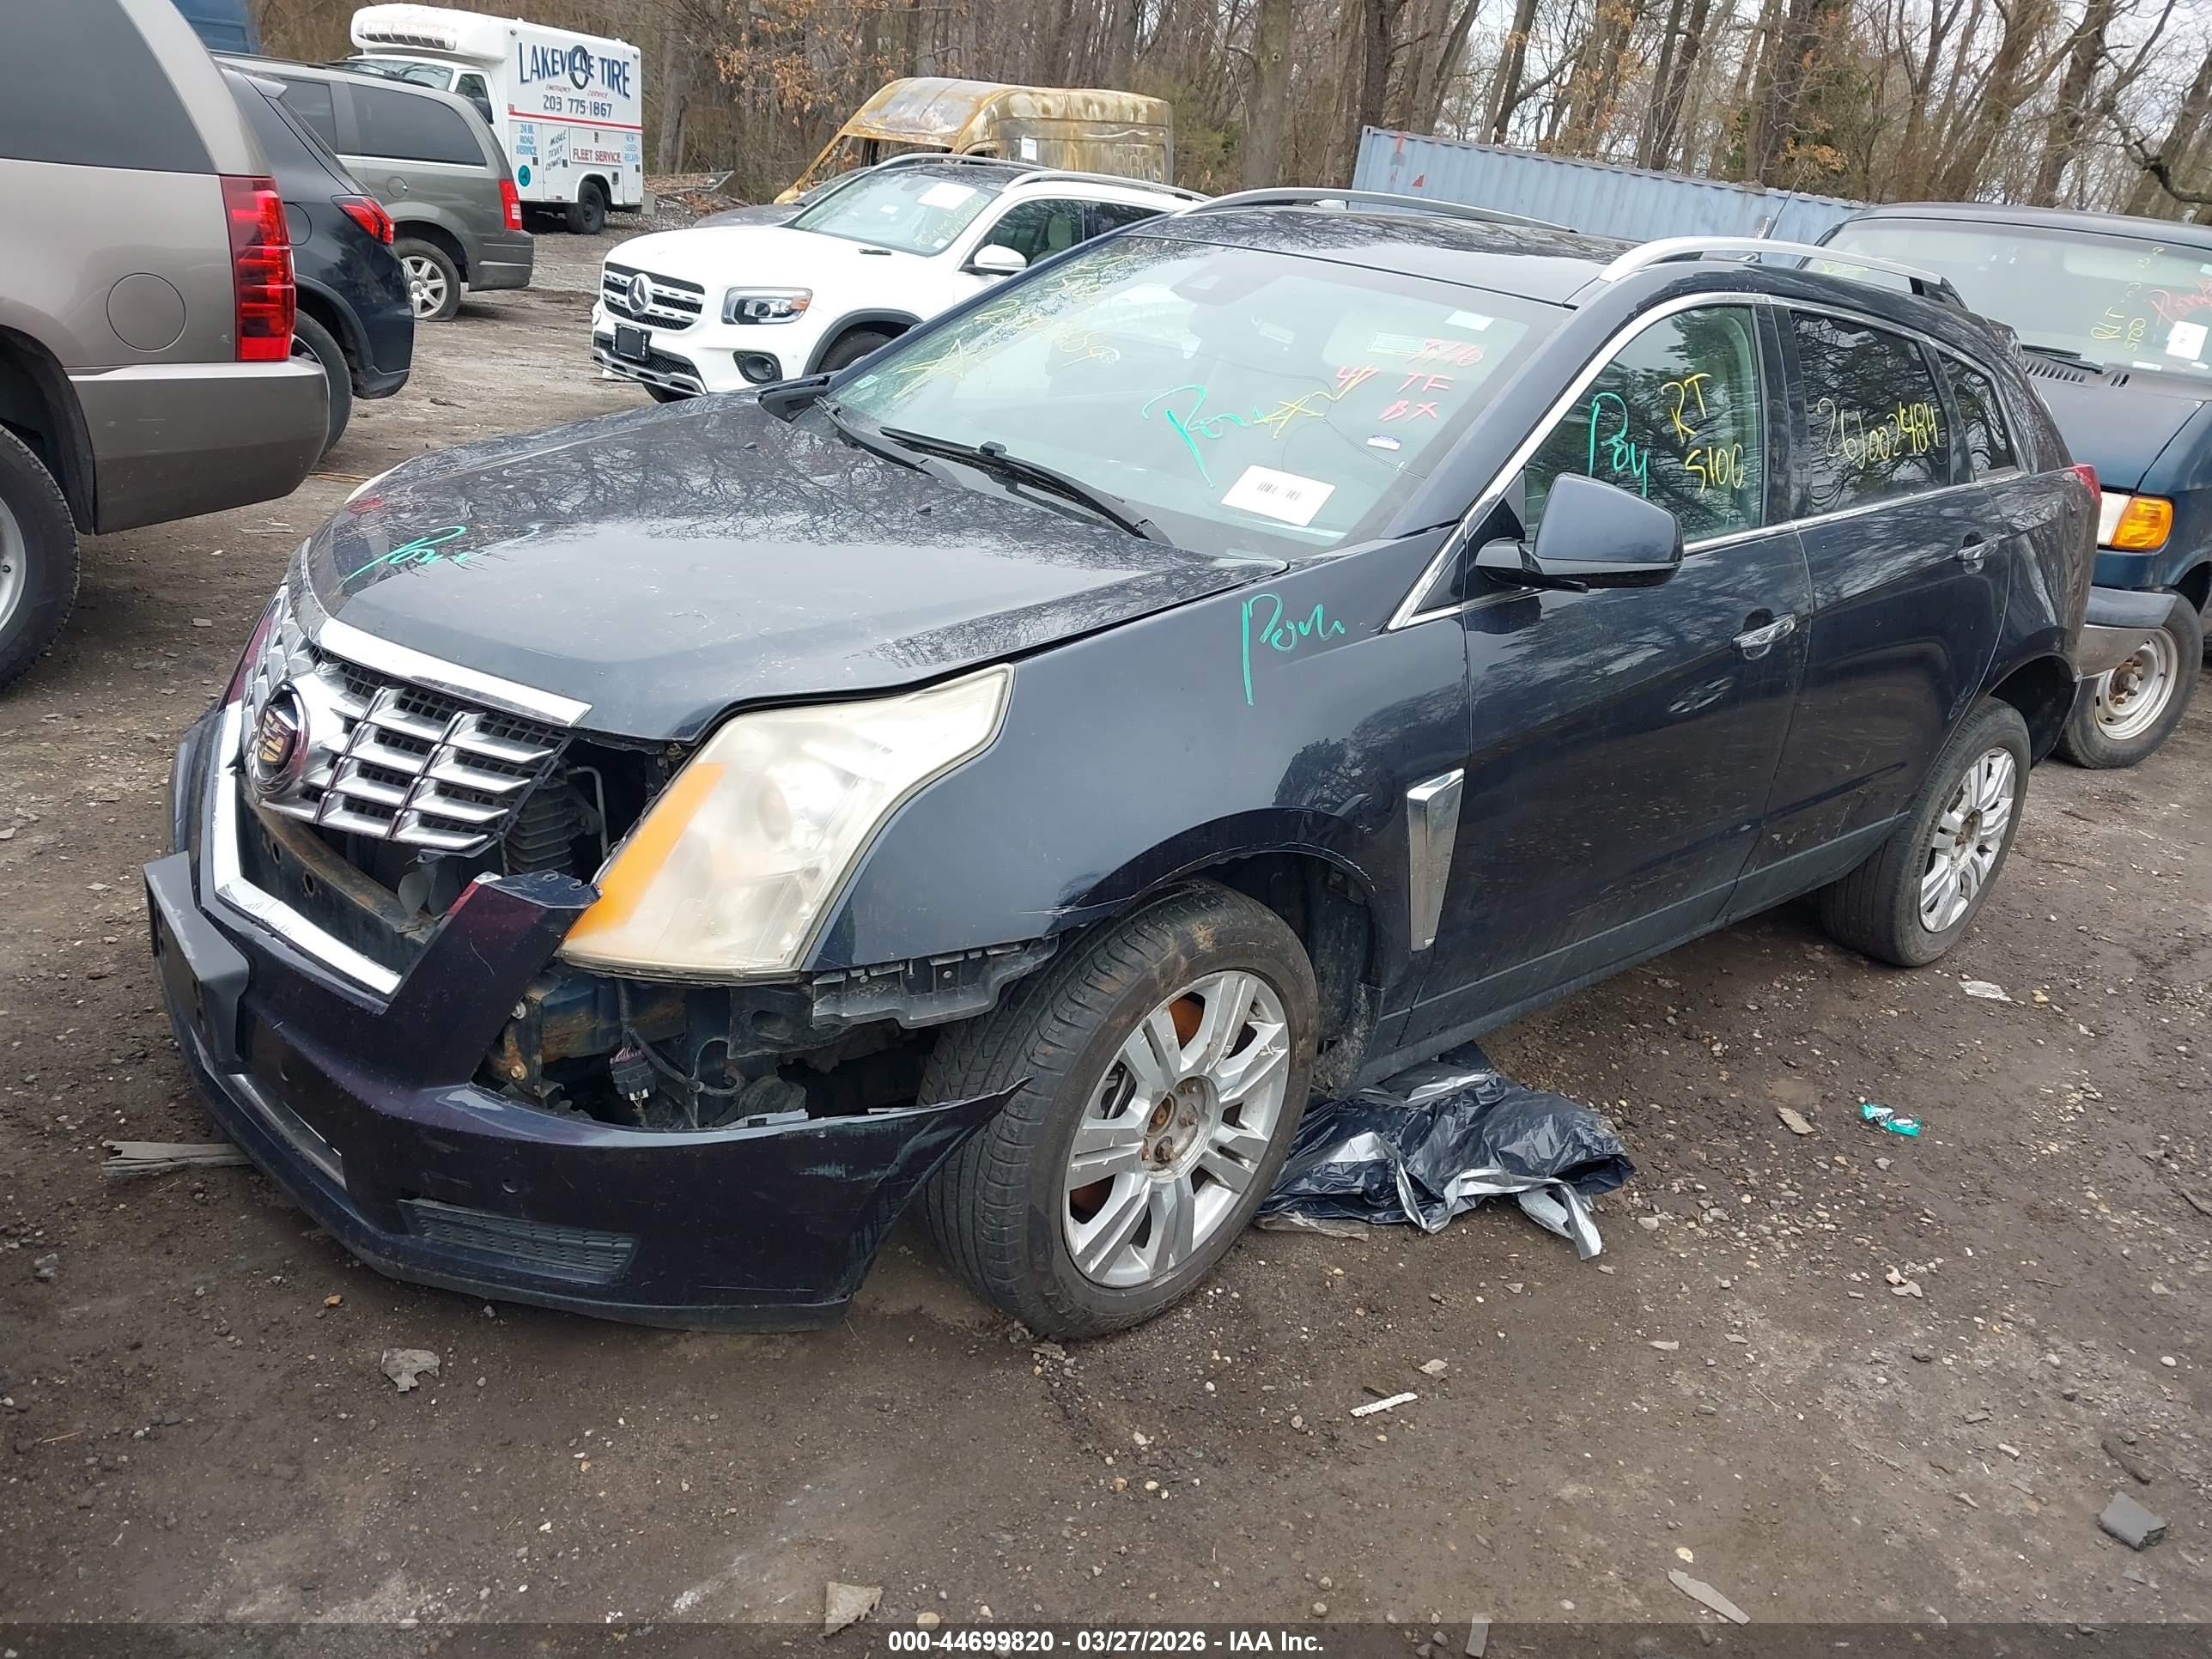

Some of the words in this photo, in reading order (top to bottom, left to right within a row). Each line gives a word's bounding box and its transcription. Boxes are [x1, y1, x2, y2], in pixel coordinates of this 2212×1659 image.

[519, 42, 594, 84] LAKEVILLE
[599, 56, 630, 100] TIRE
[544, 94, 562, 112] 203
[573, 148, 592, 161] FLEET
[595, 150, 621, 163] SERVICE
